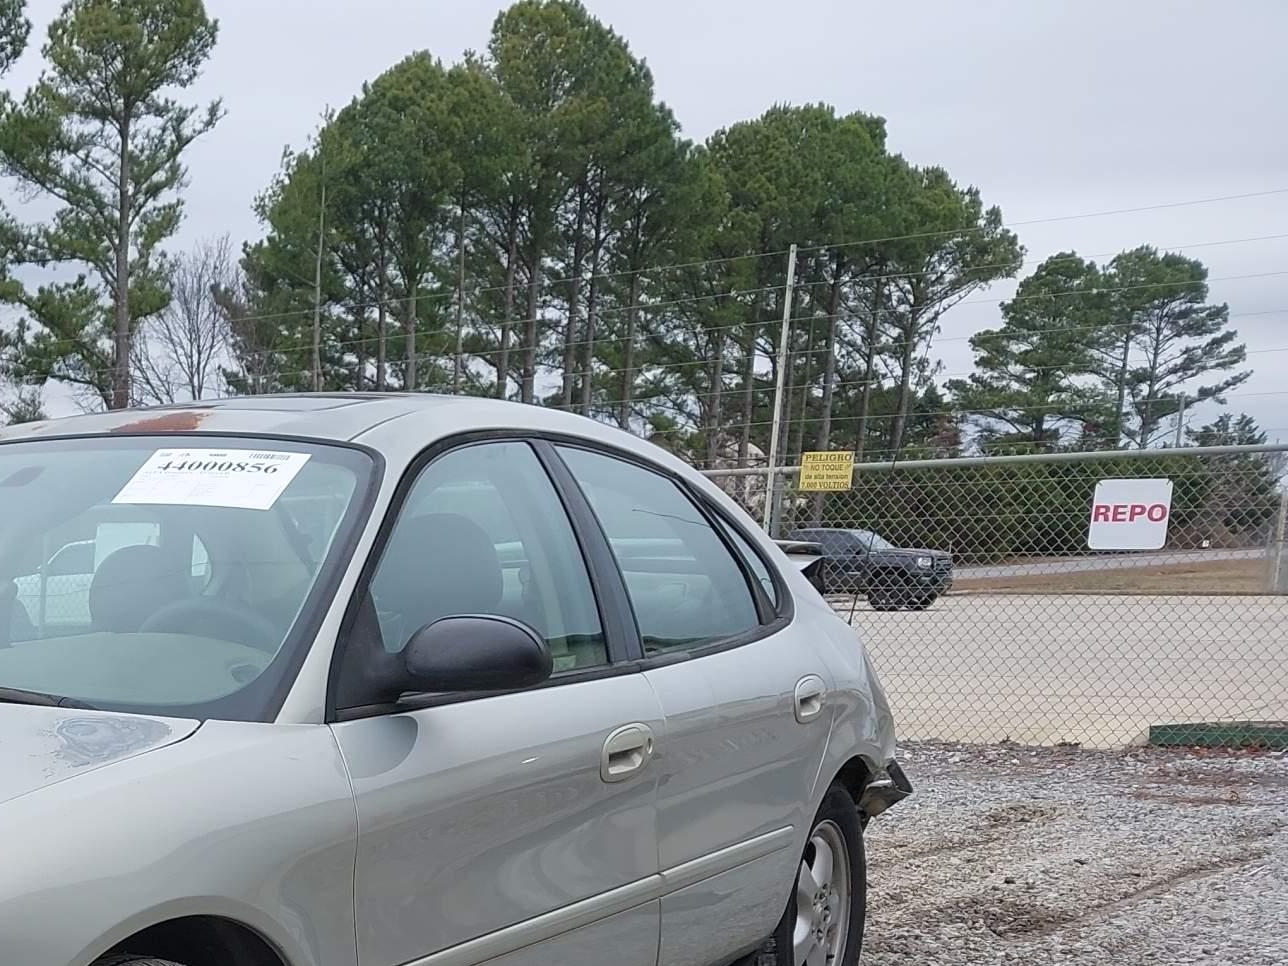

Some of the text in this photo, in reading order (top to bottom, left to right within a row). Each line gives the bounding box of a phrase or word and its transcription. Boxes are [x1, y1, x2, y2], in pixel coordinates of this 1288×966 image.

[805, 453, 852, 462] PELIGRO
[158, 460, 280, 474] 44000856
[819, 481, 849, 489] VOLTIOS
[1093, 504, 1168, 523] REPO
